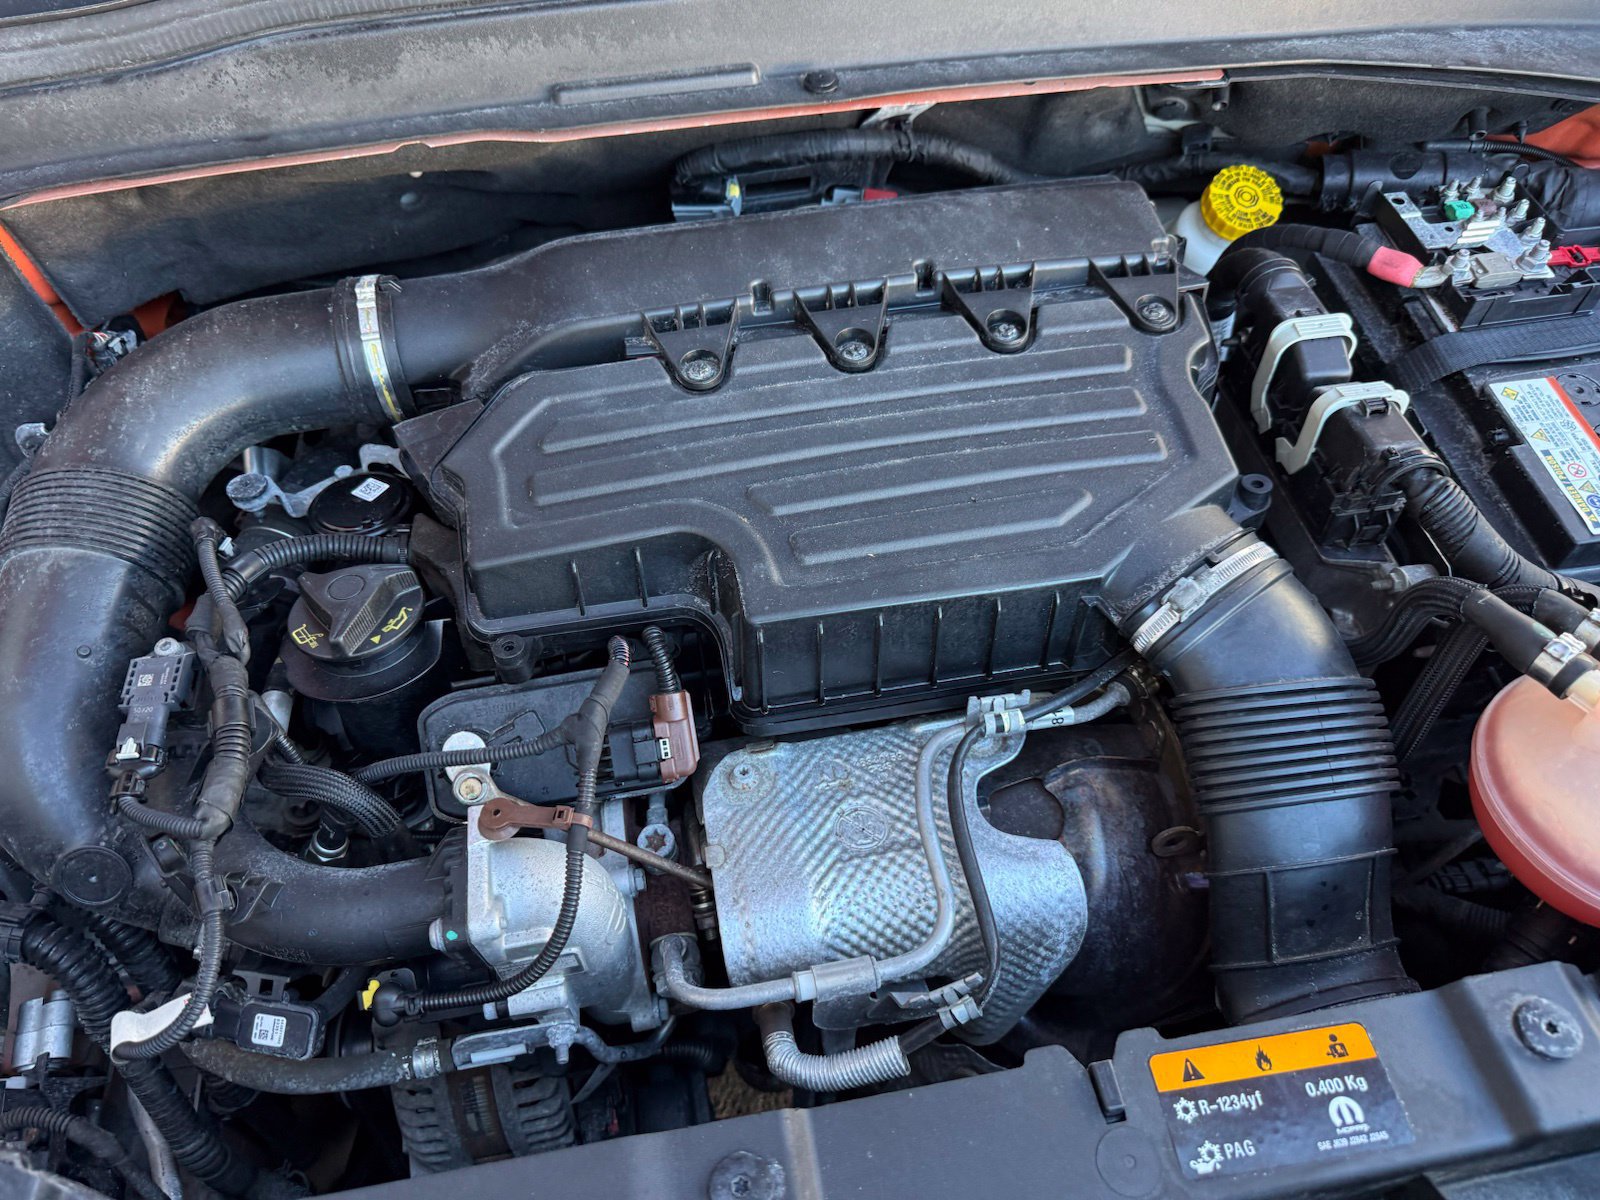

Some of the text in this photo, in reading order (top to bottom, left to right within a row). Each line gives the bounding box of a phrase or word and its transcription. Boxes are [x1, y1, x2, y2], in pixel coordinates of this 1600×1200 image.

[1545, 454, 1568, 482] POISON
[1566, 484, 1591, 513] DANGER
[1305, 1074, 1369, 1099] 0.400 Kg
[1198, 1090, 1264, 1117] R-1234yf
[1223, 1139, 1257, 1160] PAG
[1317, 1139, 1332, 1152] SAE
